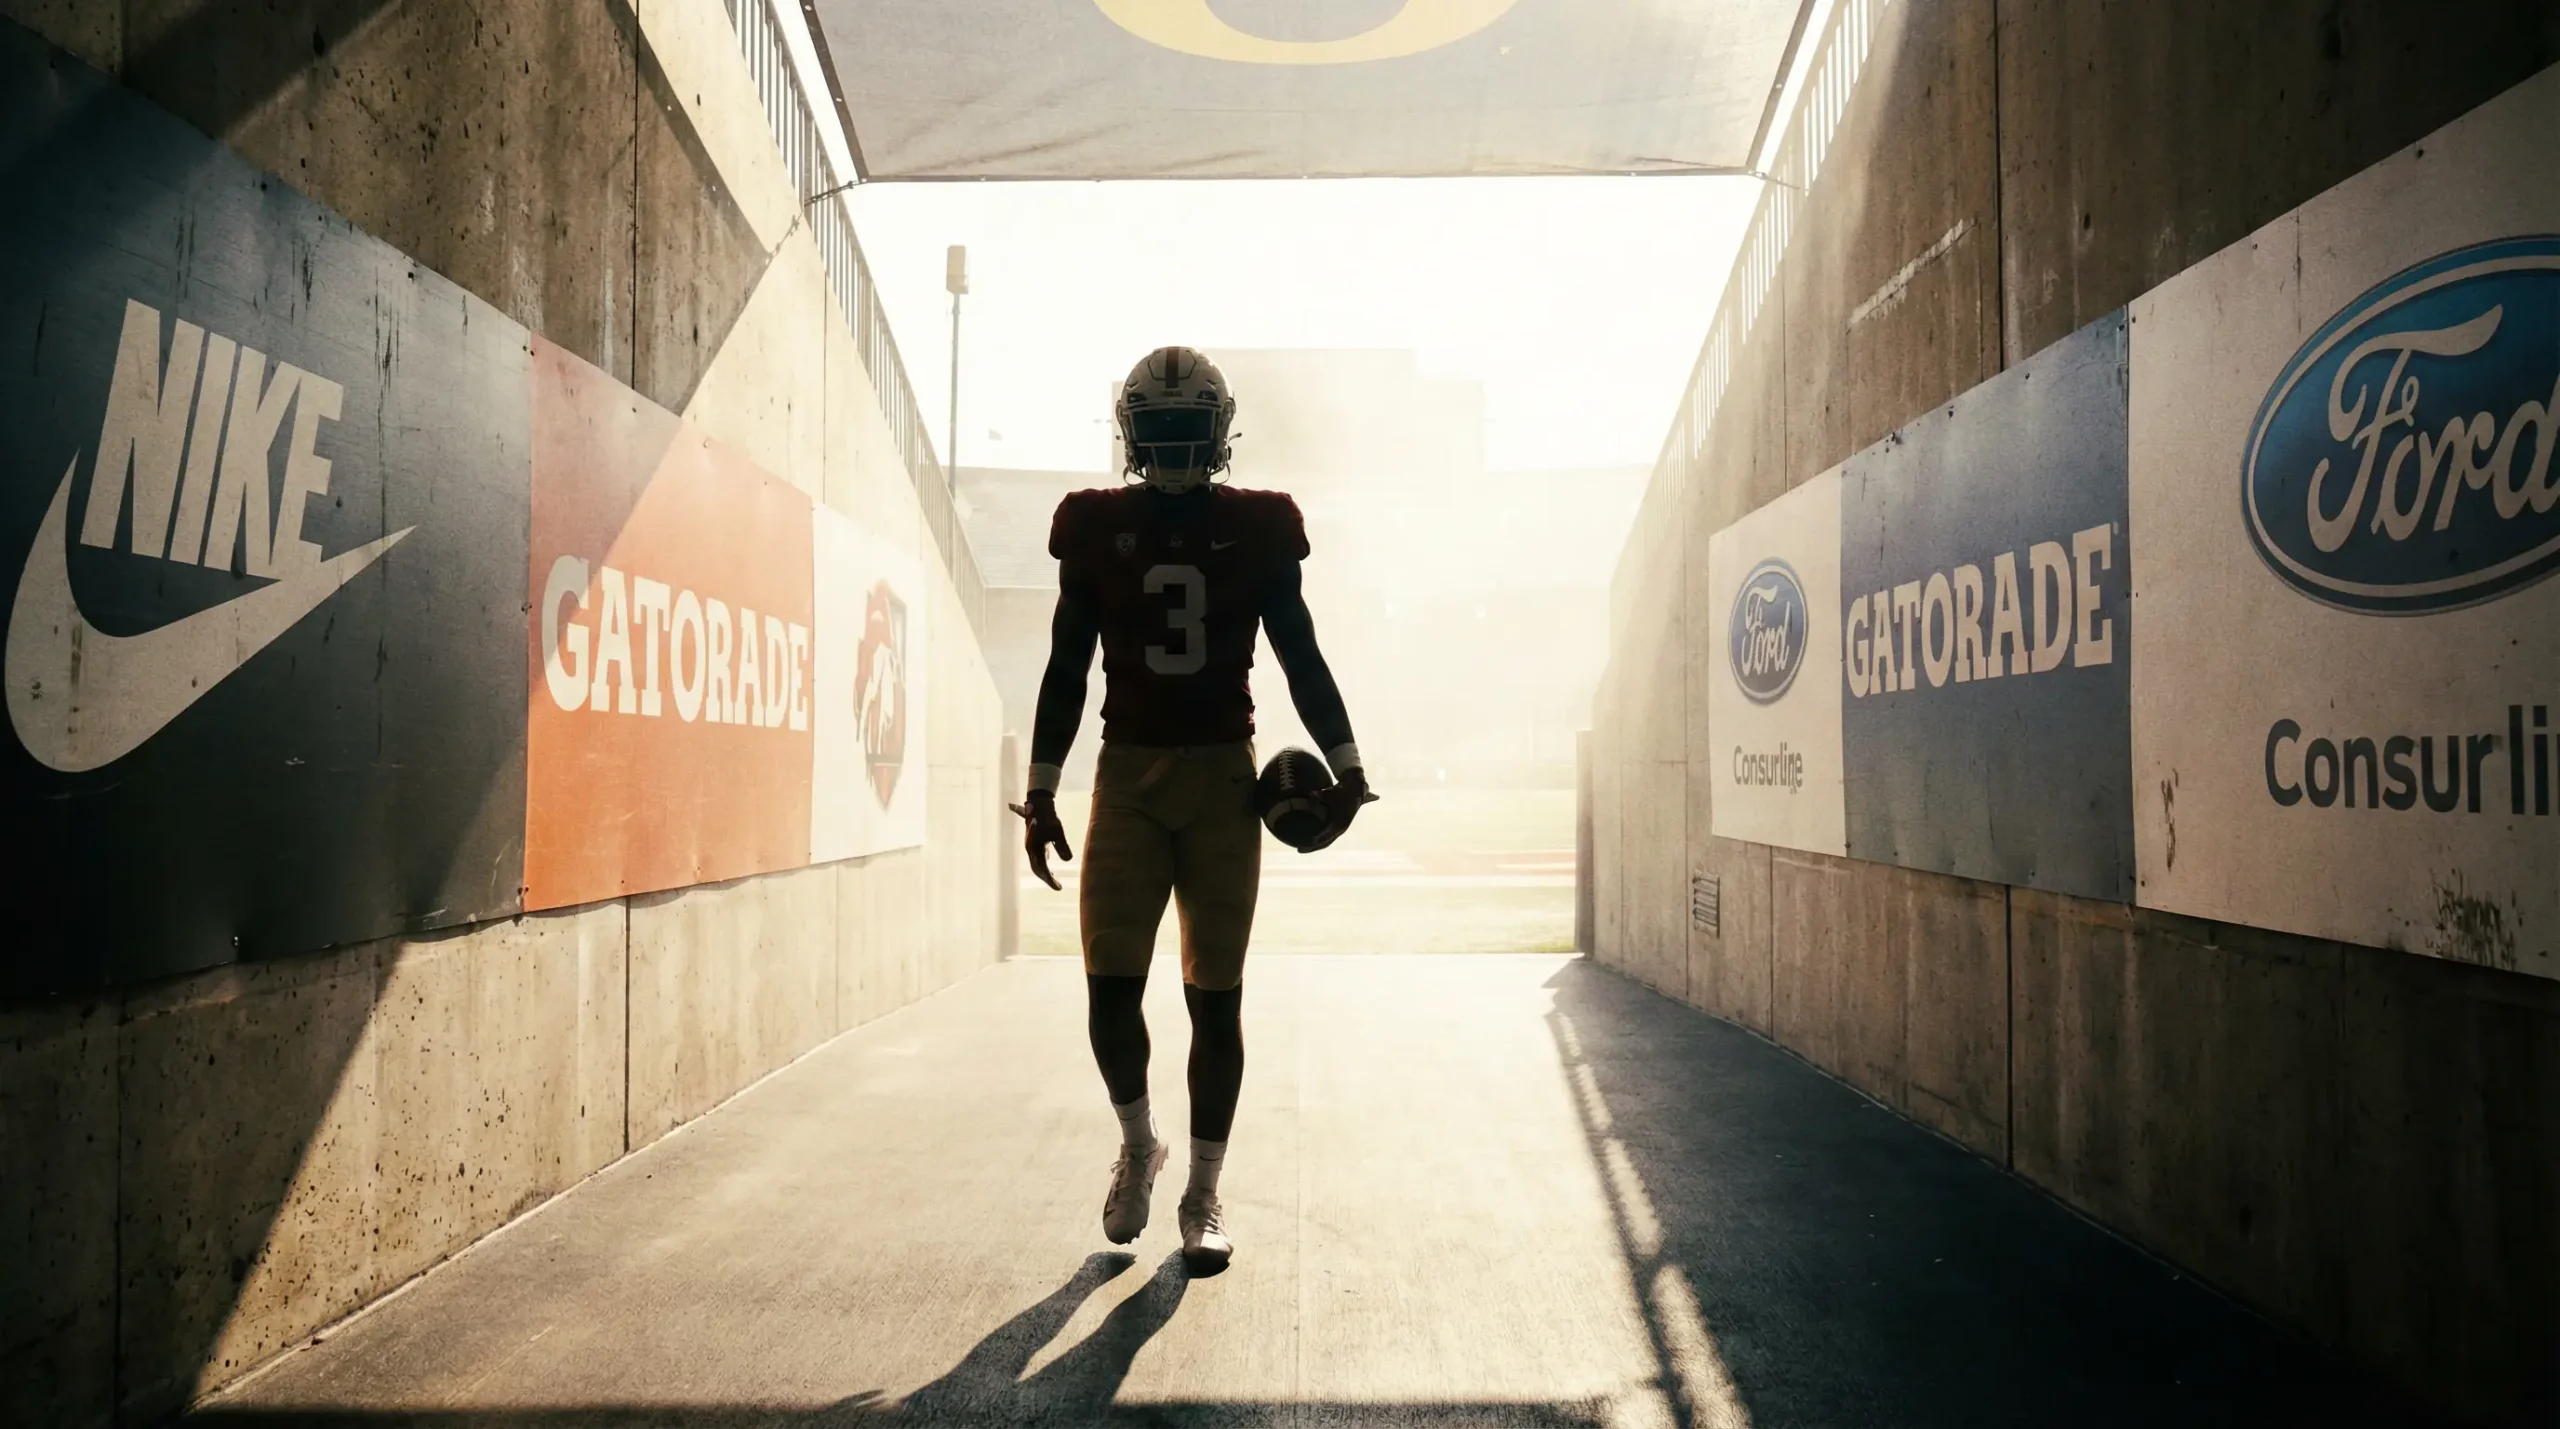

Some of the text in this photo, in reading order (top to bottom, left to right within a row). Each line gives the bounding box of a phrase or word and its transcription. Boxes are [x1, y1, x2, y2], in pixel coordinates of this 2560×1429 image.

[80, 298, 344, 579] NIKE
[542, 555, 808, 731] GATORADE
[1143, 565, 1207, 675] 3
[1741, 585, 1792, 676] Ford
[1847, 523, 2114, 698] GATORADE
[2265, 705, 2560, 816] Consurli
